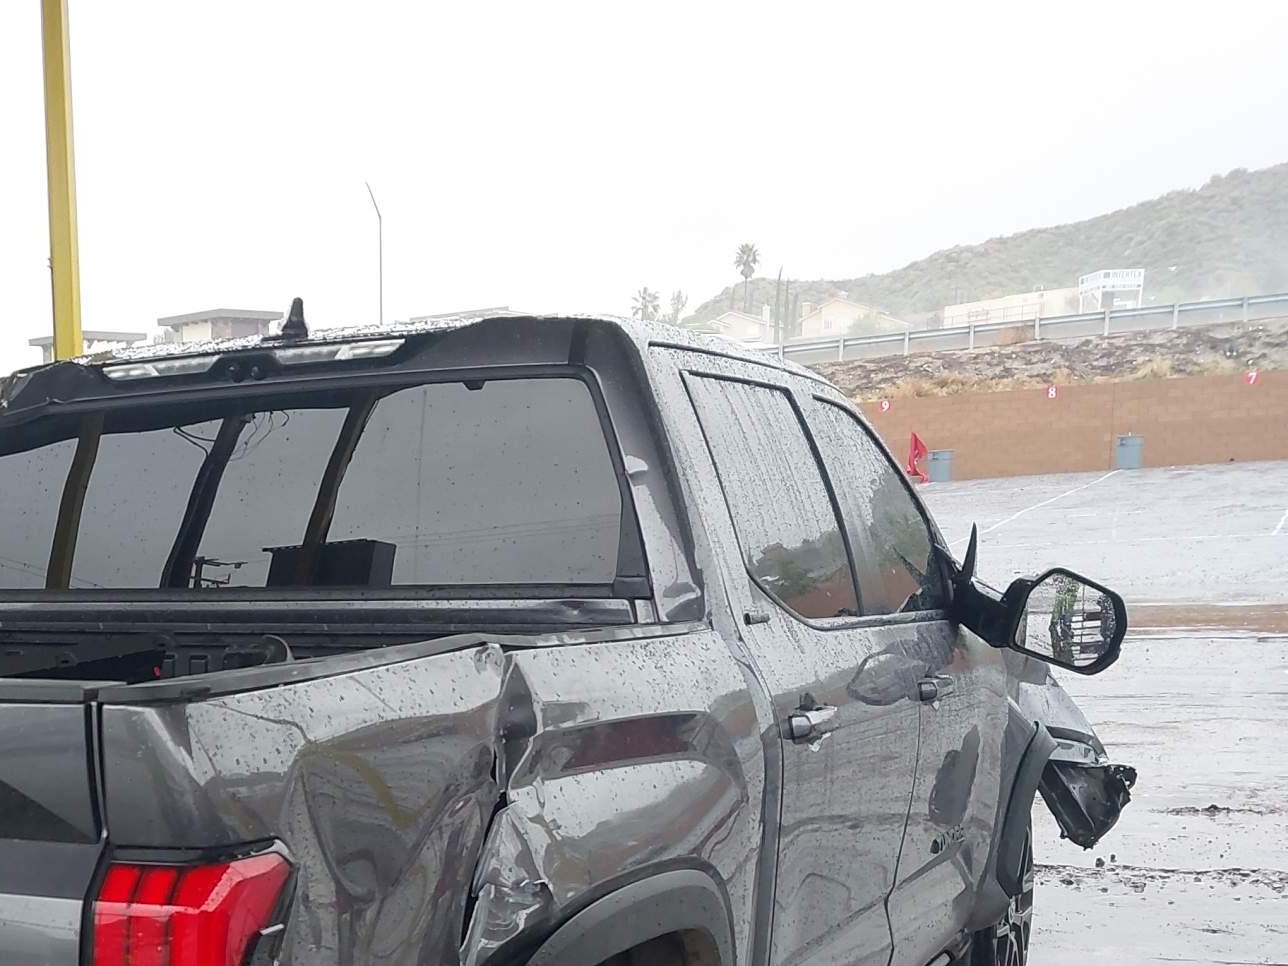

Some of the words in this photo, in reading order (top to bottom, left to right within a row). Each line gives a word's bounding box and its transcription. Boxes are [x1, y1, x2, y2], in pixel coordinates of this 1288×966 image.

[1247, 372, 1257, 385] 7
[1047, 387, 1057, 399] 8
[881, 400, 890, 412] 9
